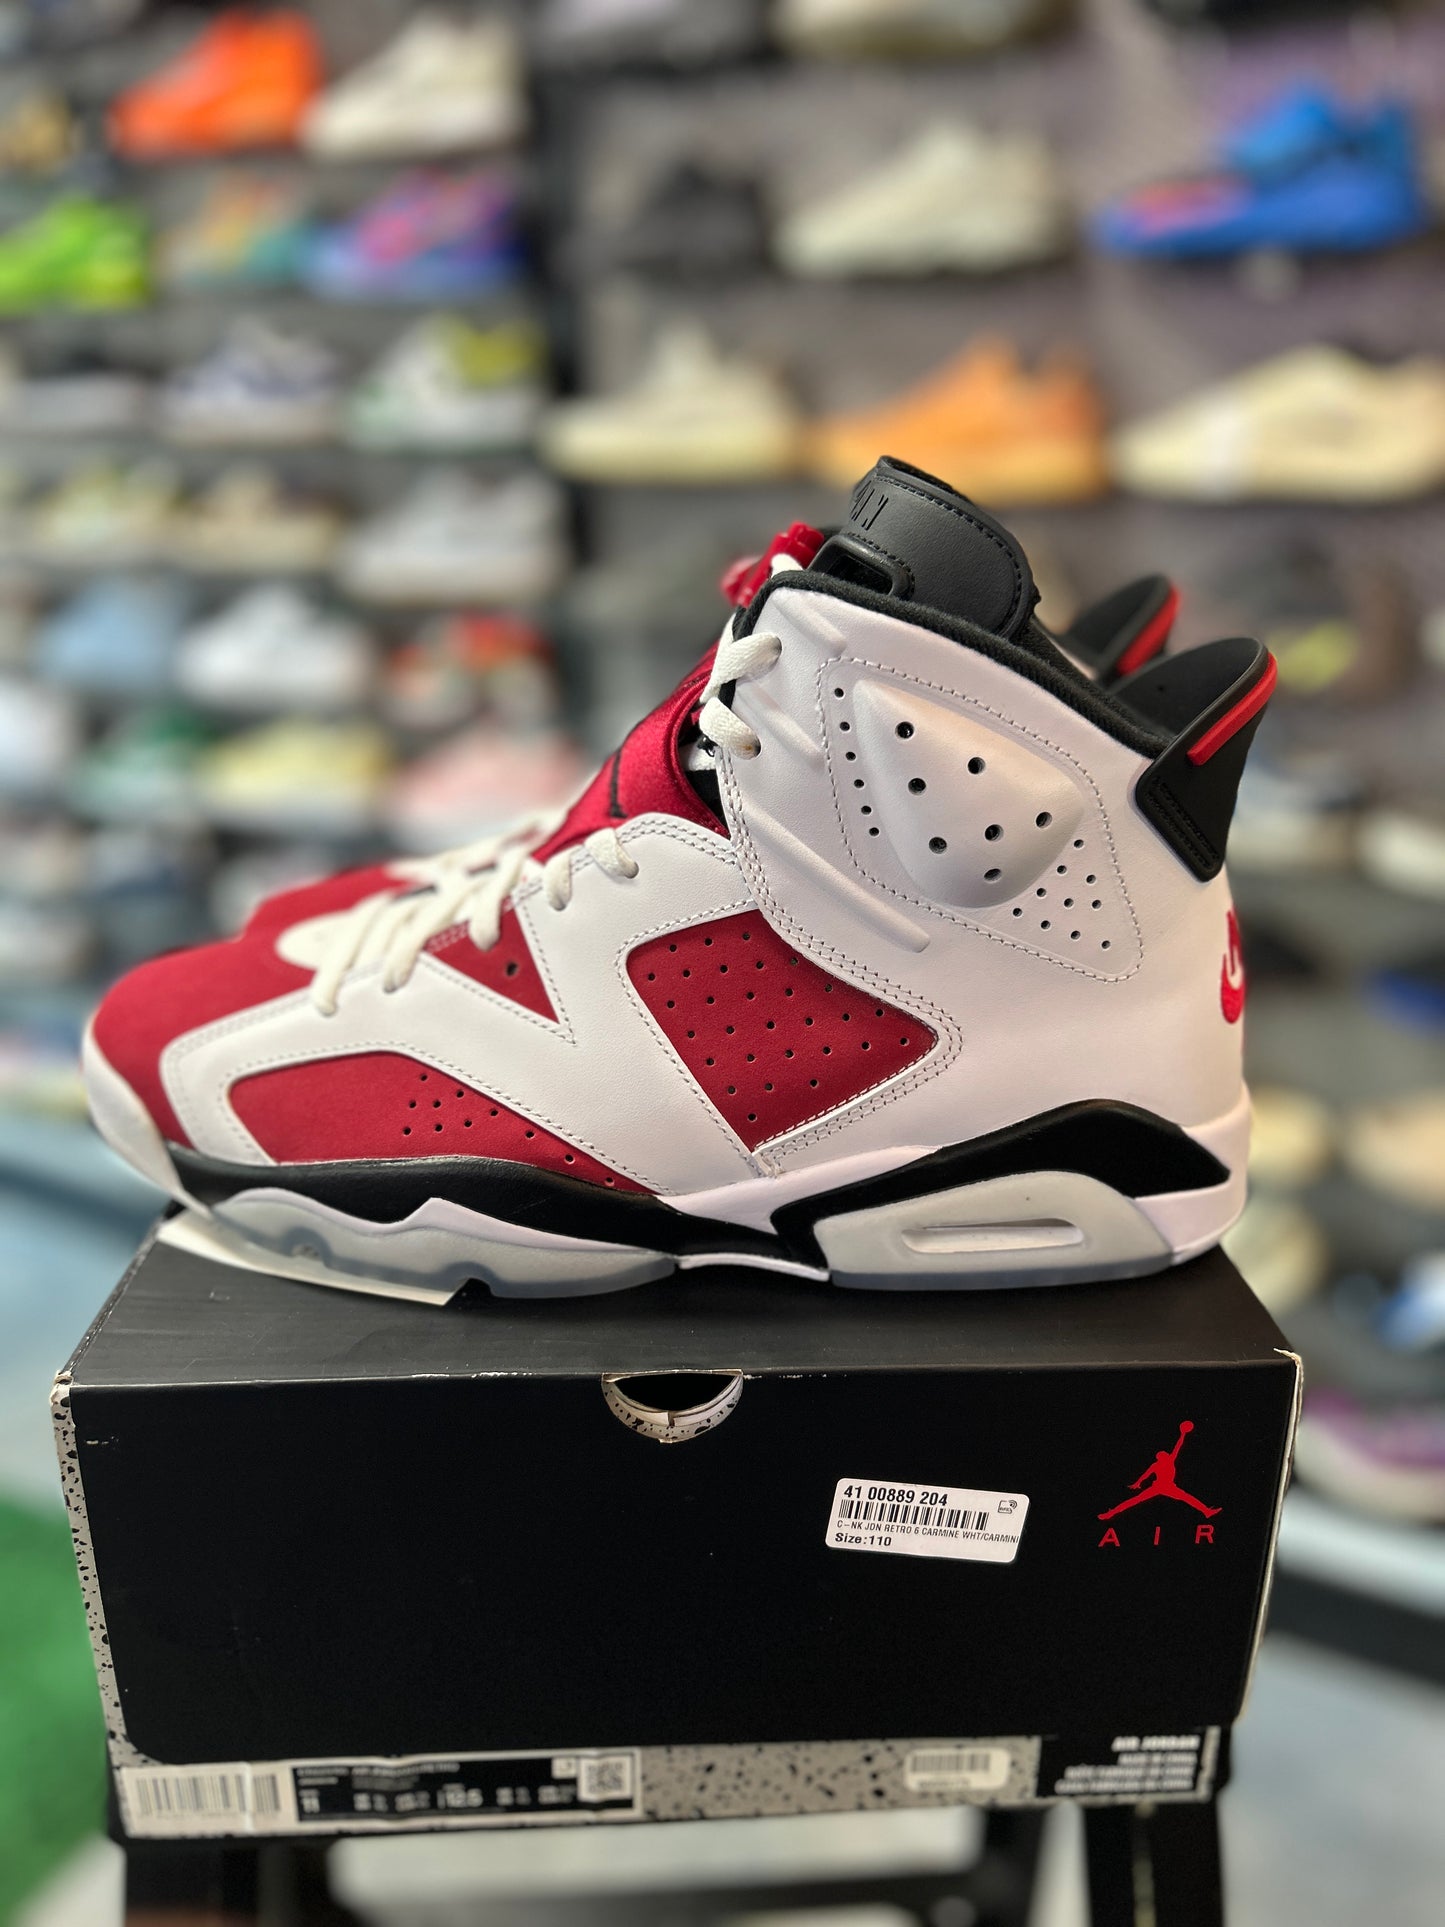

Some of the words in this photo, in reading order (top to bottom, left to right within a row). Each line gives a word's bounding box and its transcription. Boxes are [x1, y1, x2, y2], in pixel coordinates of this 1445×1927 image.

[843, 1485, 862, 1499] 41
[867, 1486, 915, 1503] 00889
[919, 1491, 948, 1506] 204
[835, 1532, 892, 1546] Size:110
[865, 1523, 882, 1532] JDN
[884, 1524, 912, 1534] RETRO
[914, 1527, 919, 1535] 6
[921, 1527, 960, 1539] CARMINE
[1098, 1524, 1215, 1547] AIR
